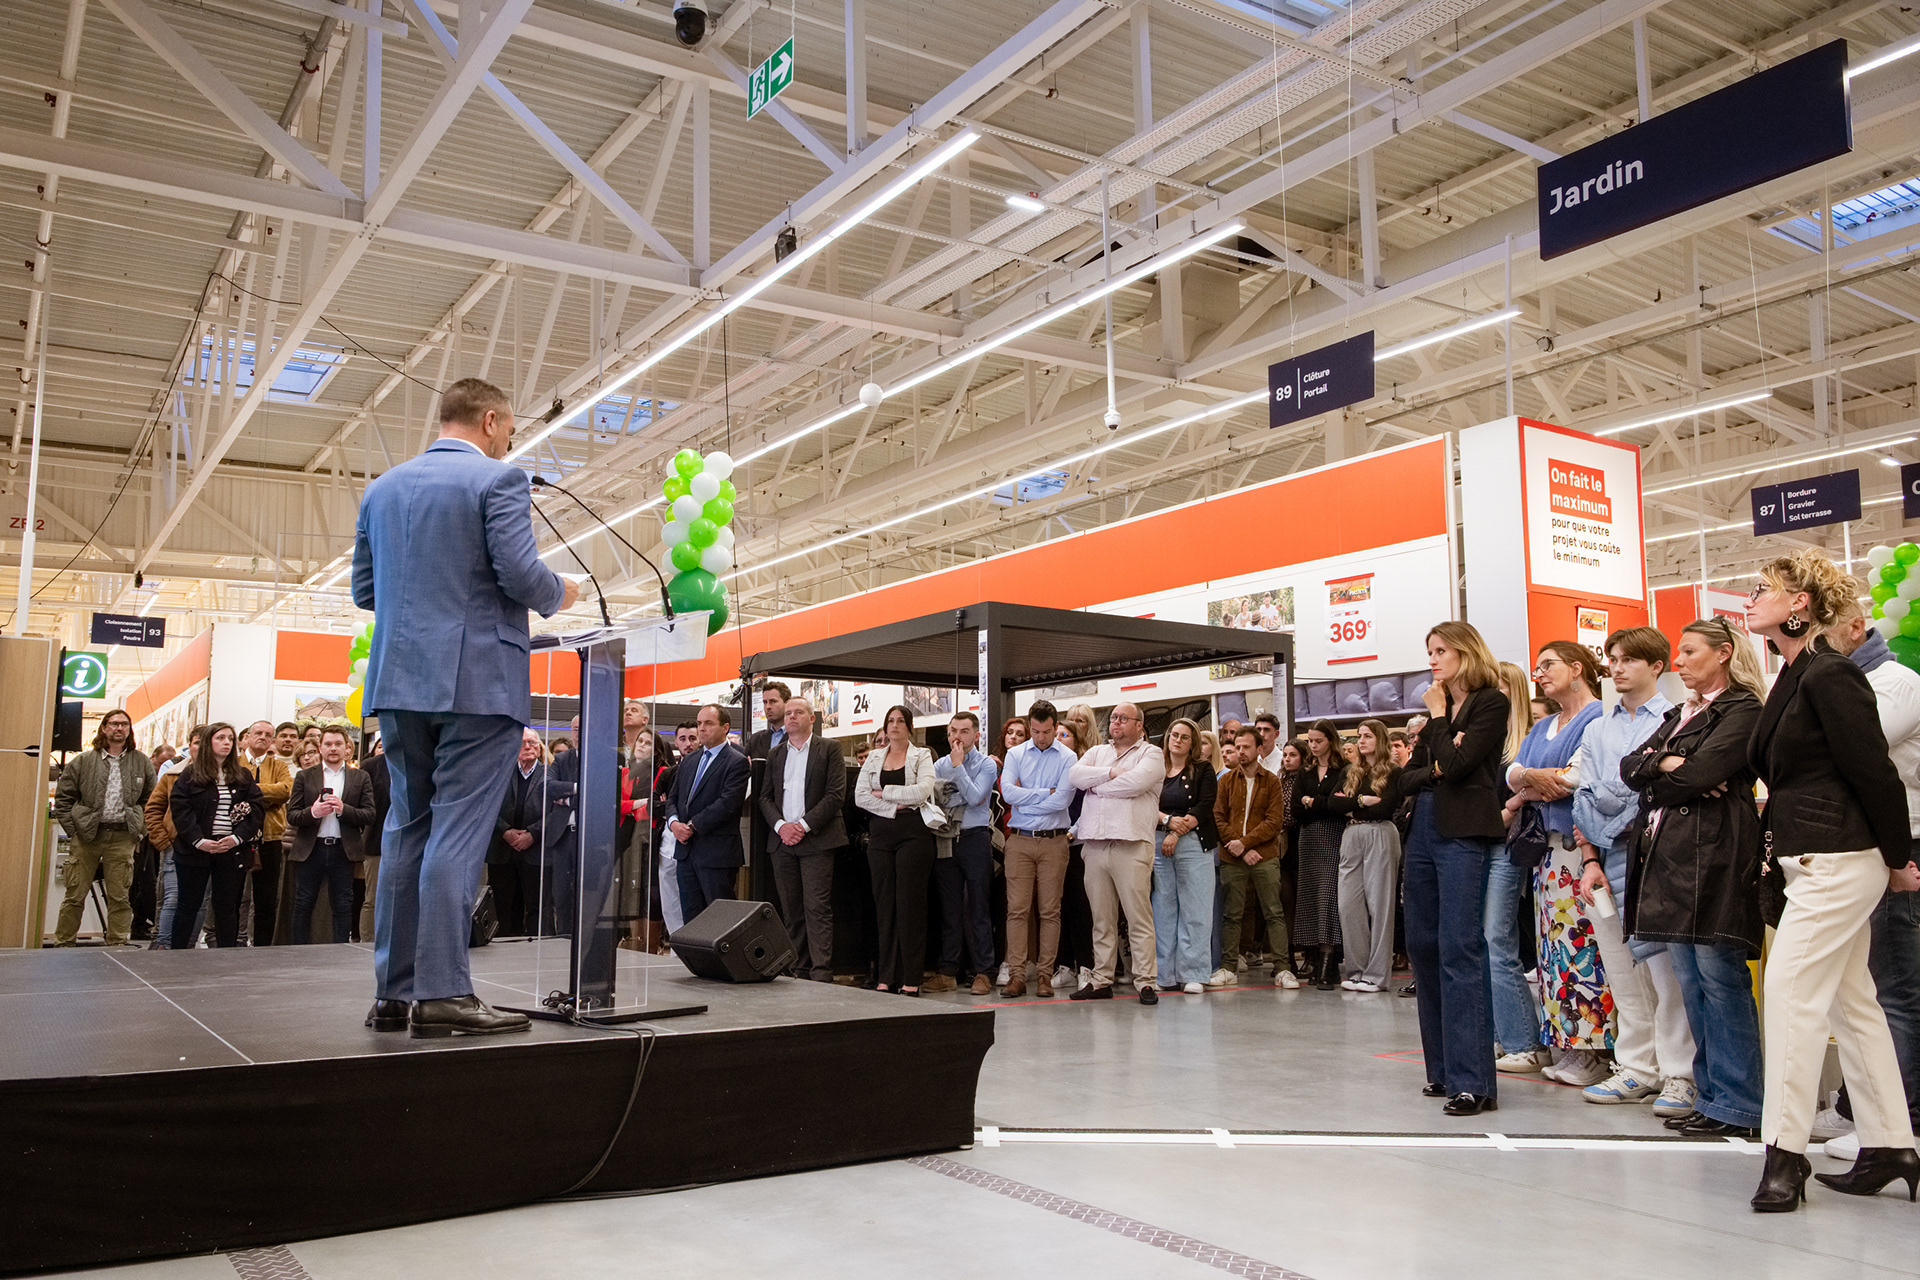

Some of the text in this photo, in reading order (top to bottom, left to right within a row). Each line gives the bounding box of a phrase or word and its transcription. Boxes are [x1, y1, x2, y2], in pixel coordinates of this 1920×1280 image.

[1549, 159, 1644, 216] Jardin
[1303, 368, 1330, 383] Clôture
[1275, 384, 1292, 402] 89
[1303, 383, 1328, 399] Portail
[1550, 467, 1602, 492] On fait le
[1787, 487, 1817, 499] Bordure
[1552, 493, 1609, 517] maximum
[1759, 504, 1776, 516] 87
[1788, 499, 1816, 511] Gravier
[1788, 508, 1832, 522] Sol terrasse
[1551, 518, 1610, 537] pour que votre
[1552, 534, 1621, 555] projet vous coûte
[1553, 549, 1600, 567] le minimum
[104, 619, 142, 627] Cloisonnement
[149, 628, 161, 636] 93
